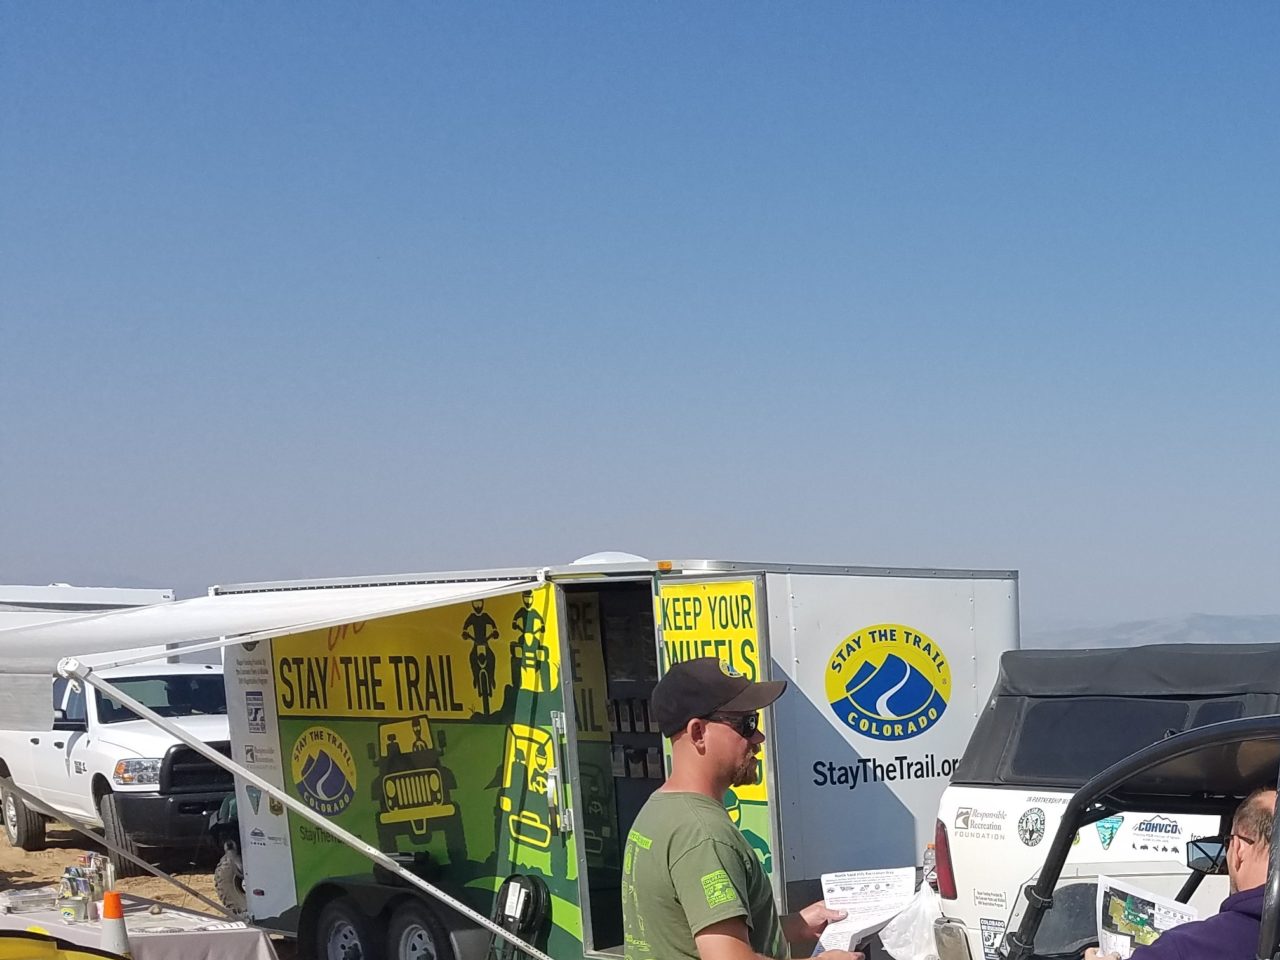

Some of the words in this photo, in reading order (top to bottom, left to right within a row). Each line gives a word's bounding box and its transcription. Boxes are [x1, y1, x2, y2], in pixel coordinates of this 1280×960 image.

[661, 597, 702, 631] KEEP
[708, 595, 753, 630] YOUR
[831, 635, 862, 674] STAY
[868, 629, 897, 643] THE
[903, 630, 945, 673] TRAIL
[279, 656, 328, 710] STAY
[339, 655, 386, 710] THE
[388, 654, 464, 712] TRAIL
[847, 706, 938, 737] COLORADO
[294, 735, 307, 762] STAY
[309, 730, 324, 741] THE
[327, 732, 351, 767] TRAIL
[303, 793, 350, 813] COLORADO
[971, 808, 1007, 820] Responsible
[954, 831, 1006, 840] FOUNDATION
[969, 819, 1002, 831] Recreation
[1138, 821, 1178, 834] COHVCO
